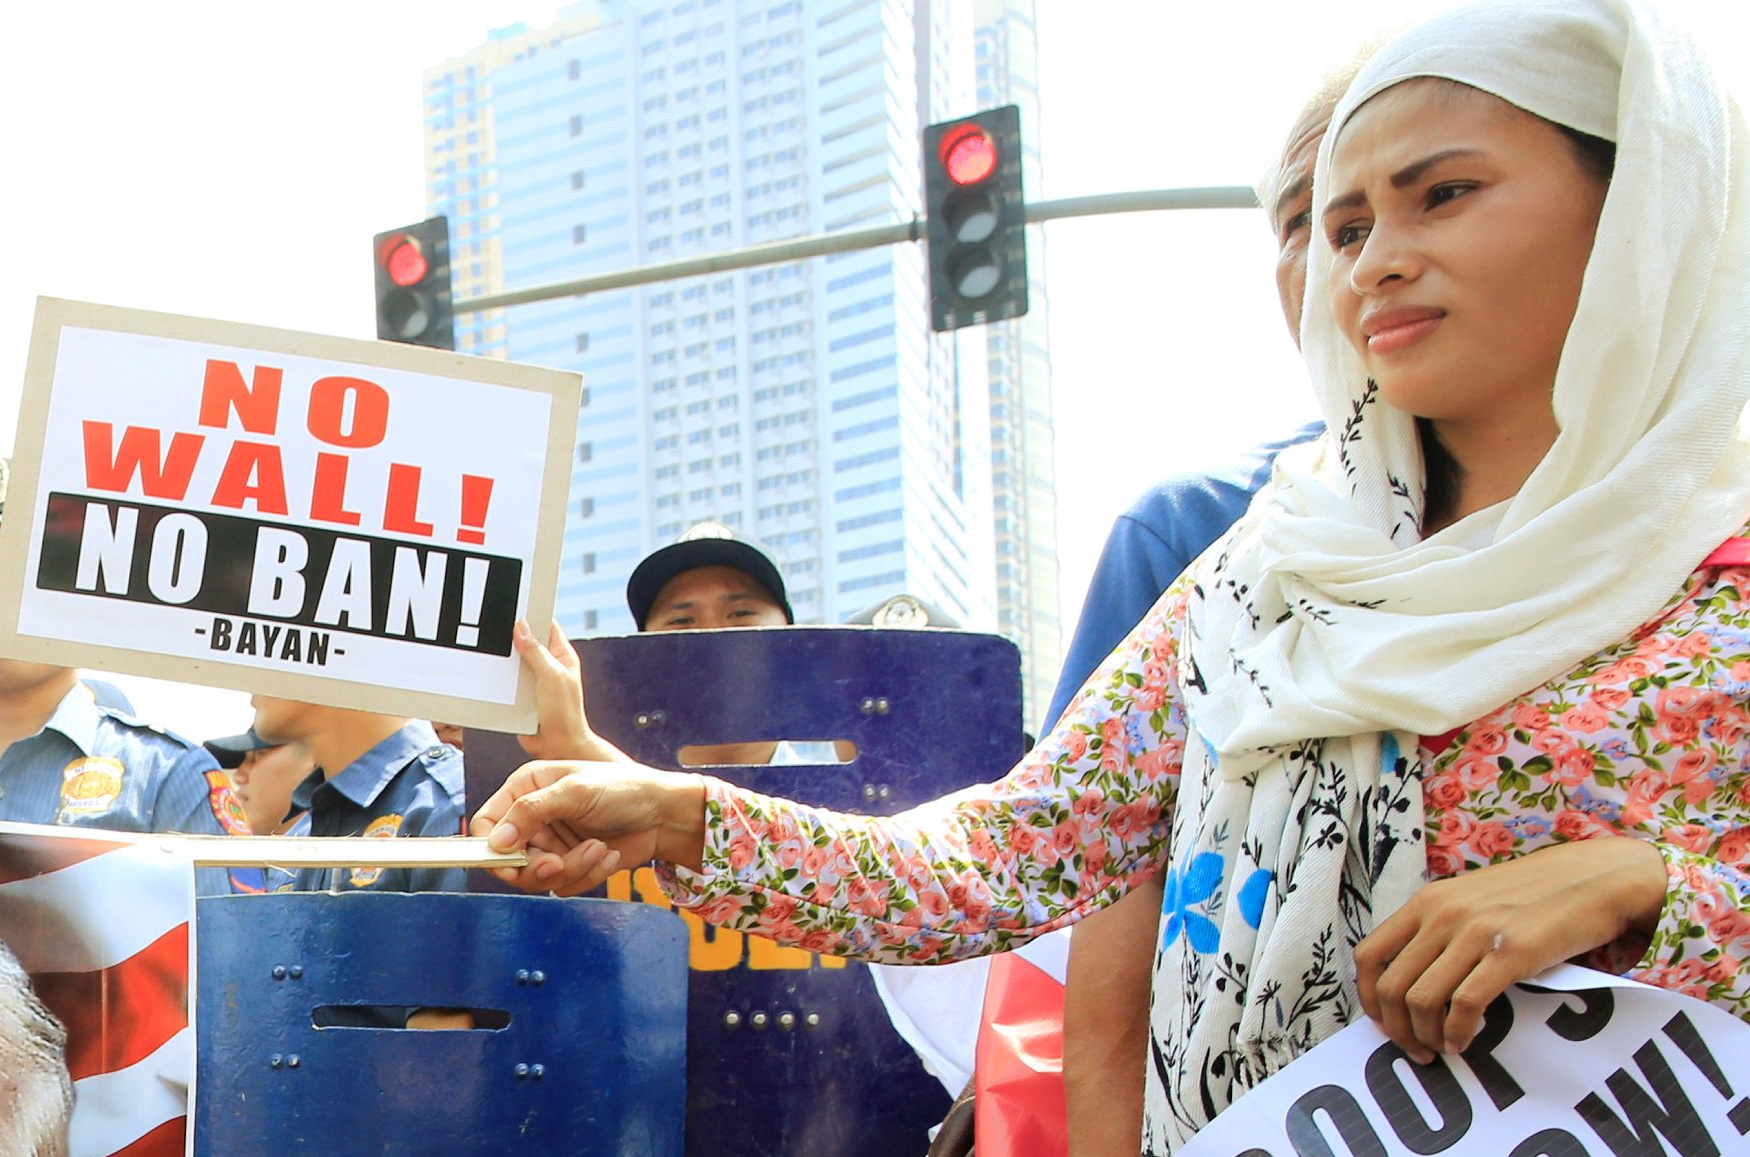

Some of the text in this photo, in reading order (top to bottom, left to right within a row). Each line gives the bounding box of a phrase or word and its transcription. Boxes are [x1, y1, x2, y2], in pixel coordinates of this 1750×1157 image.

[198, 359, 390, 449] NO
[82, 420, 494, 546] WALL!
[75, 502, 490, 648] NO BAN!
[195, 617, 345, 666] -BAYAN-
